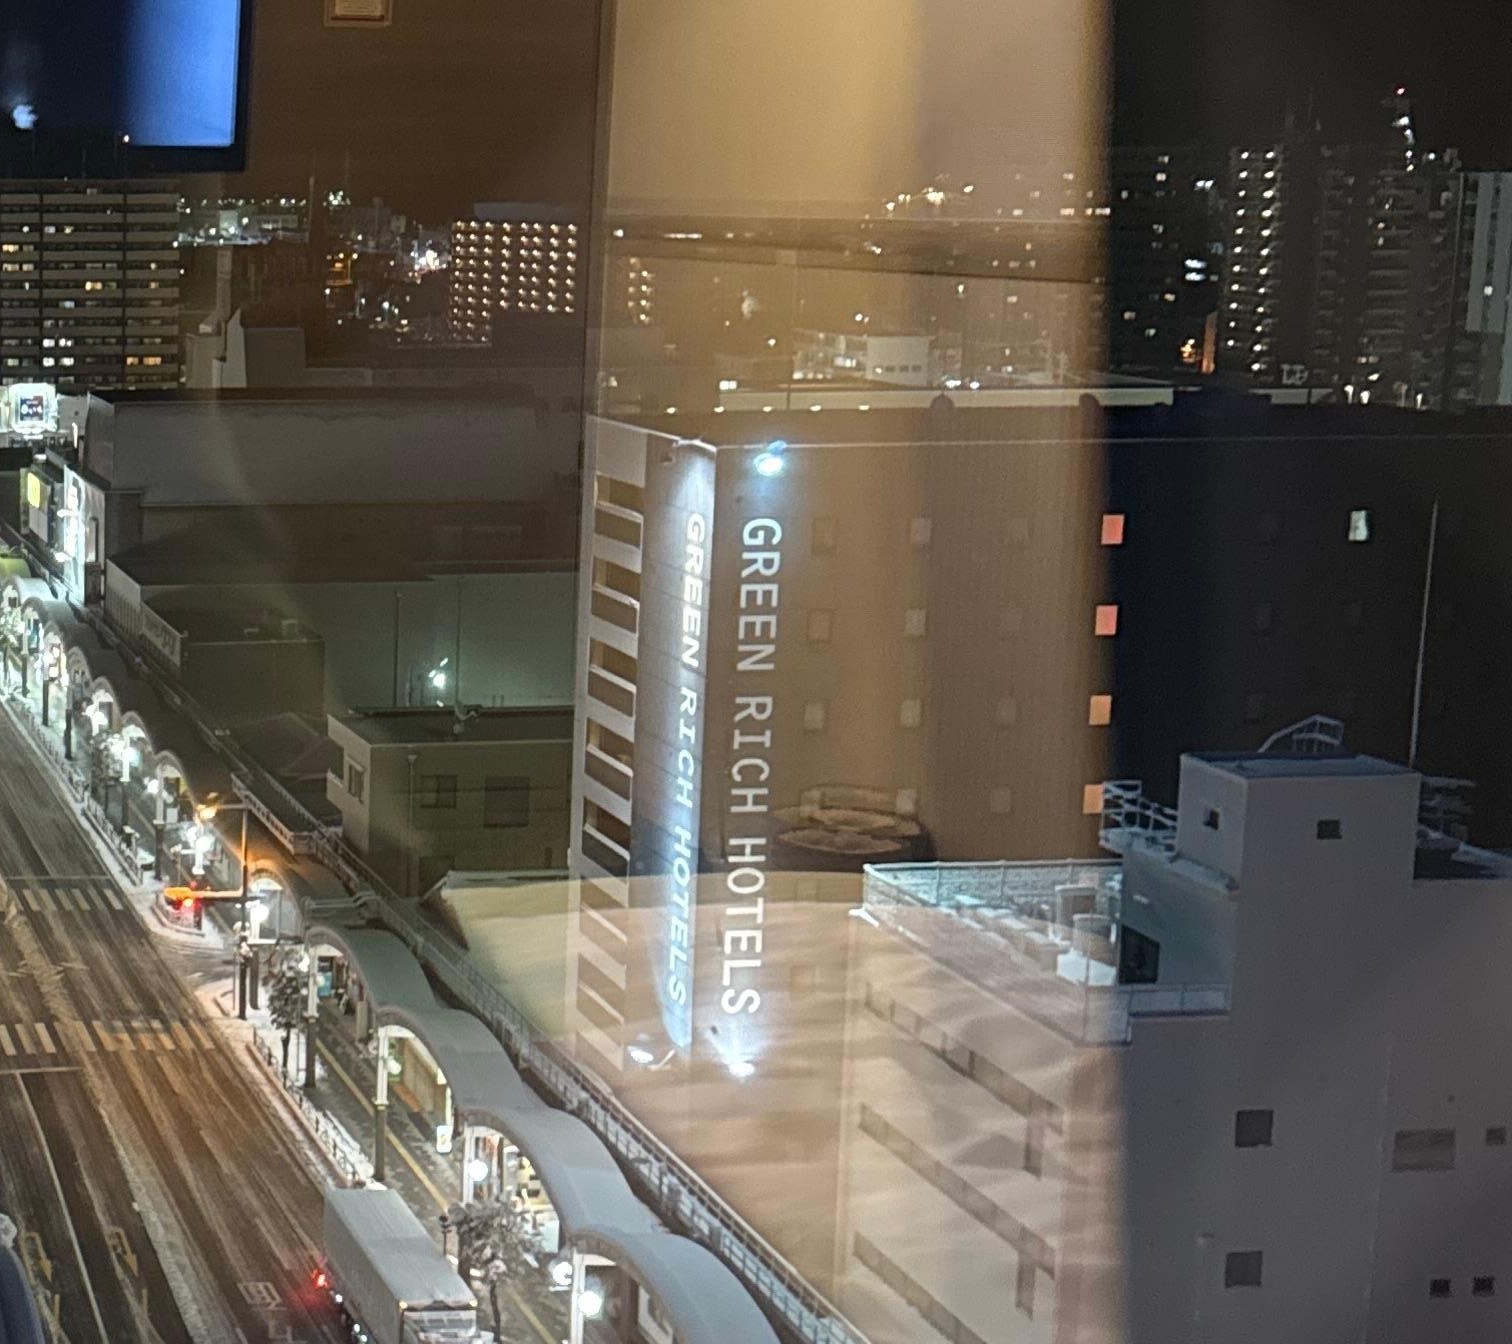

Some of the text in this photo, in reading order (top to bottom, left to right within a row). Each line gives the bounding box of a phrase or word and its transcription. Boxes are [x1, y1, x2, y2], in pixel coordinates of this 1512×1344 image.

[667, 512, 706, 1006] GREEN RICH HOTELS
[721, 517, 783, 1015] GREEN RICH HOTELS
